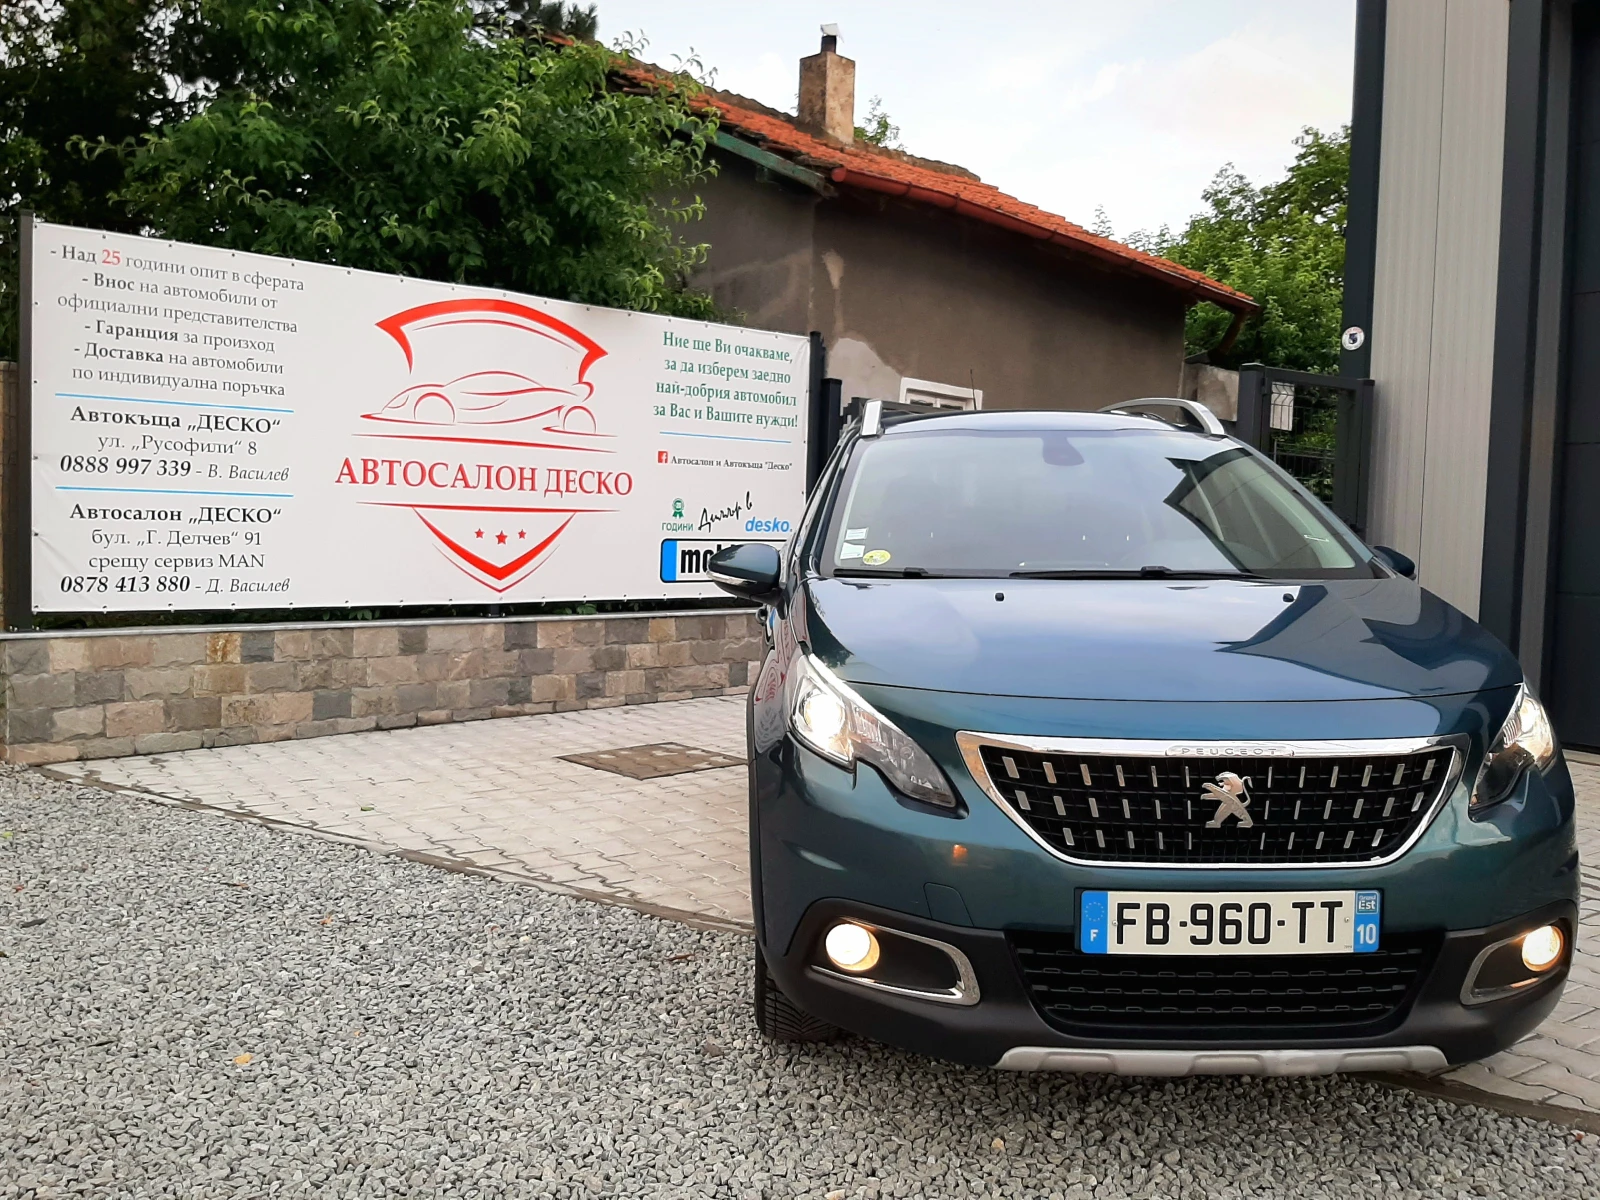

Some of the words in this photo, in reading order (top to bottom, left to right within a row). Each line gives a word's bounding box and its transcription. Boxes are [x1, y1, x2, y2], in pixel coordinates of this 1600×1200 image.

[63, 245, 96, 264] Над
[102, 250, 120, 265] 25
[127, 258, 184, 274] години
[190, 267, 227, 279] опит
[233, 272, 239, 281] в
[244, 272, 303, 291] сферата
[95, 273, 134, 290] Внос
[141, 283, 158, 293] на
[164, 286, 256, 306] автомобили
[262, 299, 276, 308] от
[58, 294, 157, 316] официални
[164, 309, 297, 332] представителства
[97, 320, 178, 341] Гаранция
[184, 333, 197, 343] за
[204, 336, 274, 352] произход
[663, 331, 689, 348] Ние
[693, 340, 711, 351] ще
[716, 339, 730, 354] Ви
[735, 346, 792, 363] очакваме,
[85, 342, 163, 362] Доставка
[169, 355, 186, 364] на
[192, 357, 282, 374] автомобили
[73, 369, 93, 379] по
[99, 371, 217, 391] индивидуална
[223, 382, 284, 396] поръчка
[665, 360, 676, 370] за
[680, 362, 694, 372] да
[698, 362, 748, 381] изберем
[752, 370, 790, 383] заедно
[656, 382, 730, 402] най-добрия
[734, 391, 796, 406] автомобил
[71, 406, 181, 429] Автокъща
[188, 414, 280, 433] „ДЕСКО“
[654, 406, 665, 416] за
[671, 403, 690, 418] Вас
[695, 409, 702, 419] и
[707, 406, 752, 423] Вашите
[756, 415, 797, 429] нужди!
[98, 437, 124, 452] ул.
[132, 435, 241, 456] „Русофили“
[248, 442, 256, 455] 8
[60, 455, 108, 473] 0888
[116, 458, 152, 474] 997
[157, 460, 191, 476] 339
[208, 464, 222, 478] В.
[229, 465, 289, 481] Василев
[672, 456, 713, 466] Автосалон
[724, 460, 762, 468] Автокъща
[335, 458, 537, 491] АВТОСАЛОН
[544, 469, 632, 498] ДЕСКО
[70, 504, 182, 520] Автосалон
[189, 507, 281, 525] „ДЕСКО“
[92, 529, 130, 549] бул.
[137, 530, 161, 546] „Г.
[167, 531, 238, 547] Делчев“
[245, 532, 260, 545] 91
[662, 523, 693, 532] ГОДИНИ
[89, 558, 148, 572] срещу
[155, 558, 213, 572] сервиз
[61, 576, 108, 592] 0878
[115, 576, 149, 592] 413
[156, 576, 190, 592] 880
[205, 579, 223, 594] Д.
[230, 578, 290, 592] Василев
[1181, 747, 1277, 756] PEUGEOT
[1359, 900, 1375, 909] Est
[1116, 901, 1343, 945] FB-960-TT
[1357, 924, 1376, 944] 10
[1090, 929, 1099, 942] F
